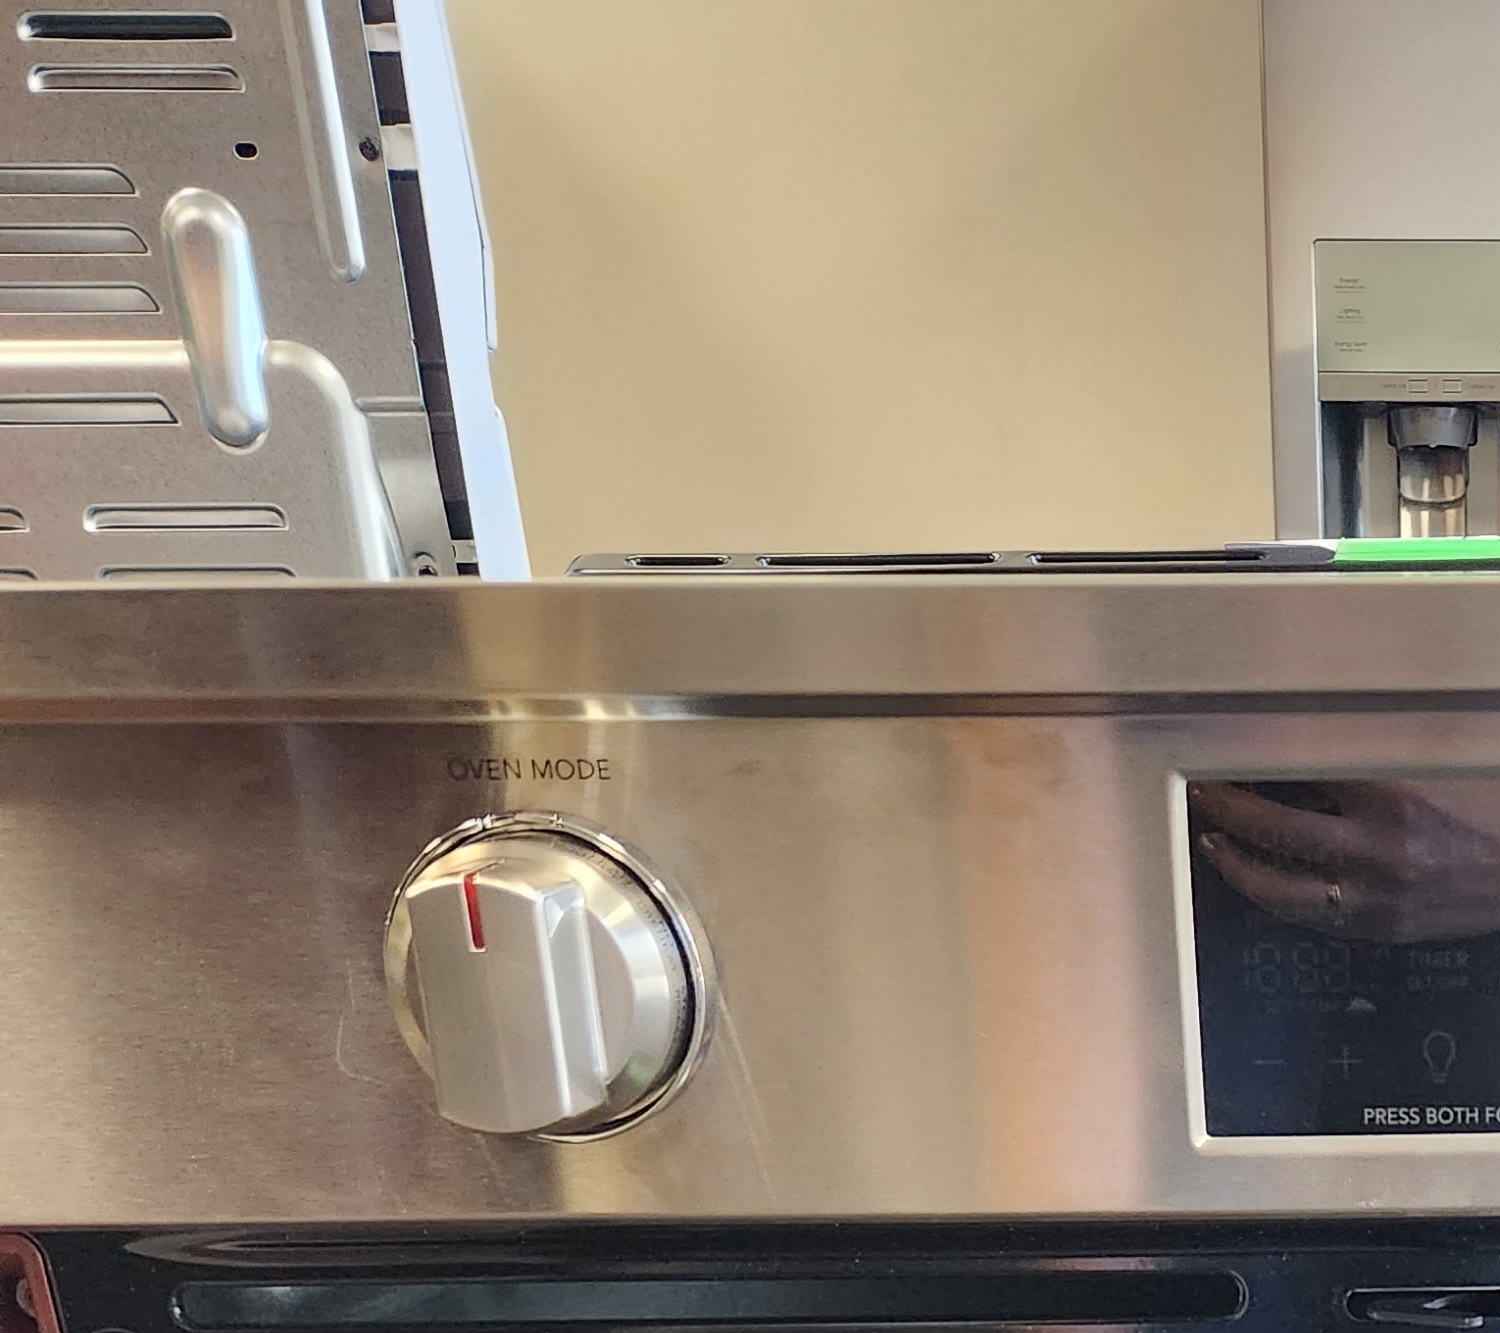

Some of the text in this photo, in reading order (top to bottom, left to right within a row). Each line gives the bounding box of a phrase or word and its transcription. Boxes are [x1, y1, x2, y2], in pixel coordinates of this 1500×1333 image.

[447, 758, 611, 781] OVEN MODE
[1363, 1107, 1421, 1125] PRESS
[1426, 1106, 1479, 1125] BOTH
